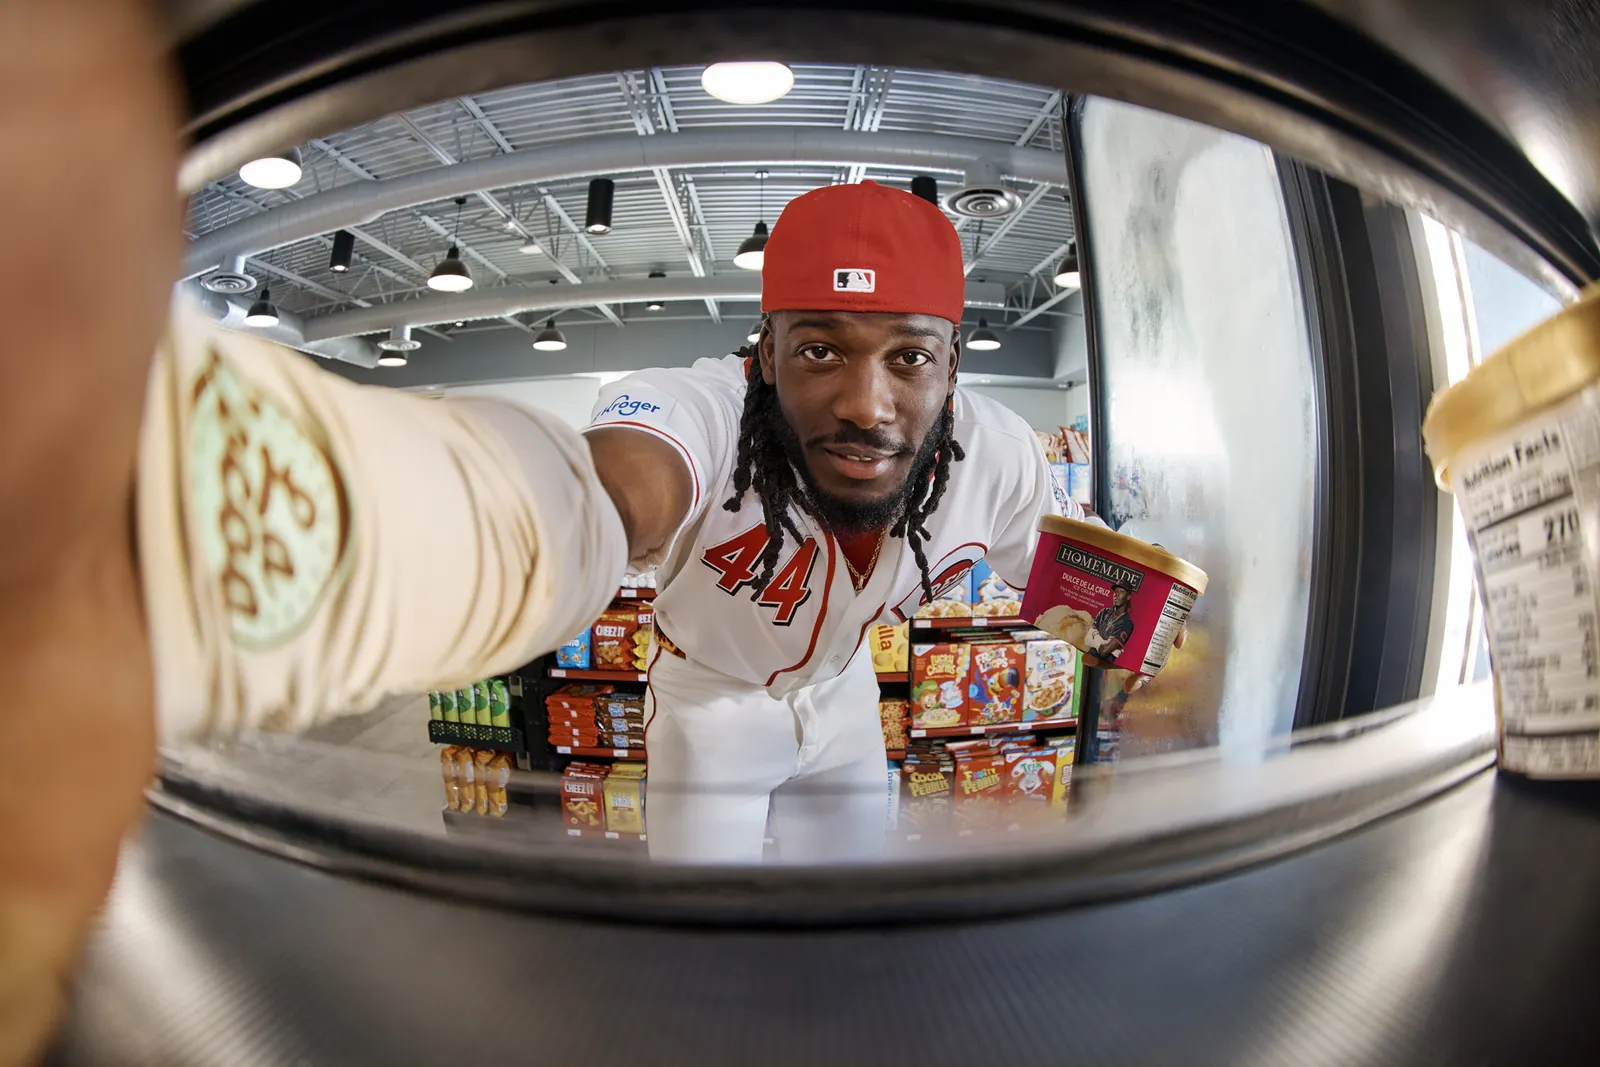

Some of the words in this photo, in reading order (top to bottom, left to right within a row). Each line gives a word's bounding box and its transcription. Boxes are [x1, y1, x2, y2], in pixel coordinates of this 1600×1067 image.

[1543, 508, 1580, 542] 270
[700, 522, 820, 627] 44
[1061, 548, 1139, 587] HOMEMADE
[1062, 572, 1080, 585] DULCE
[1080, 579, 1088, 589] DE
[1088, 582, 1095, 592] LA
[1095, 586, 1111, 597] CRUZ
[1081, 587, 1096, 597] CREAM
[1172, 583, 1189, 596] Nutrition
[878, 625, 894, 651] illa
[1021, 760, 1042, 773] Trix
